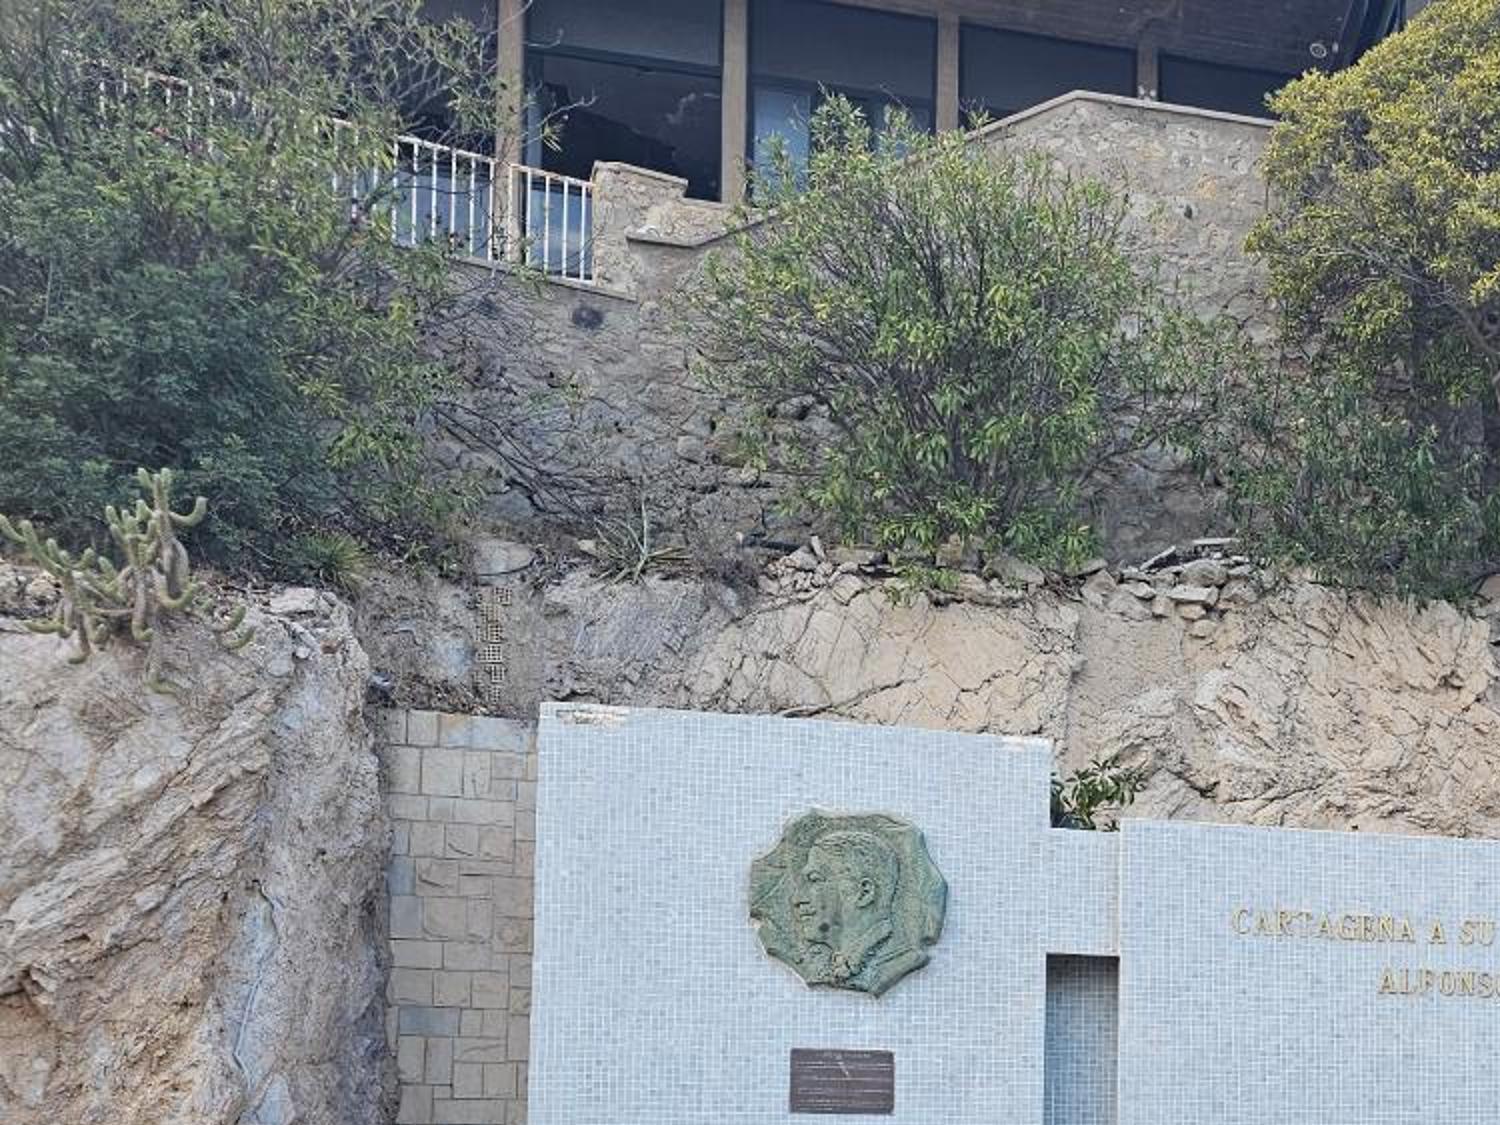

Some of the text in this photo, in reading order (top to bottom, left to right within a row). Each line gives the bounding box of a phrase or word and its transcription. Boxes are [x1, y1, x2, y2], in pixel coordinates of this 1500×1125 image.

[1231, 908, 1417, 943] CARTAGENA
[1427, 920, 1448, 945] A
[1458, 920, 1495, 946] SU
